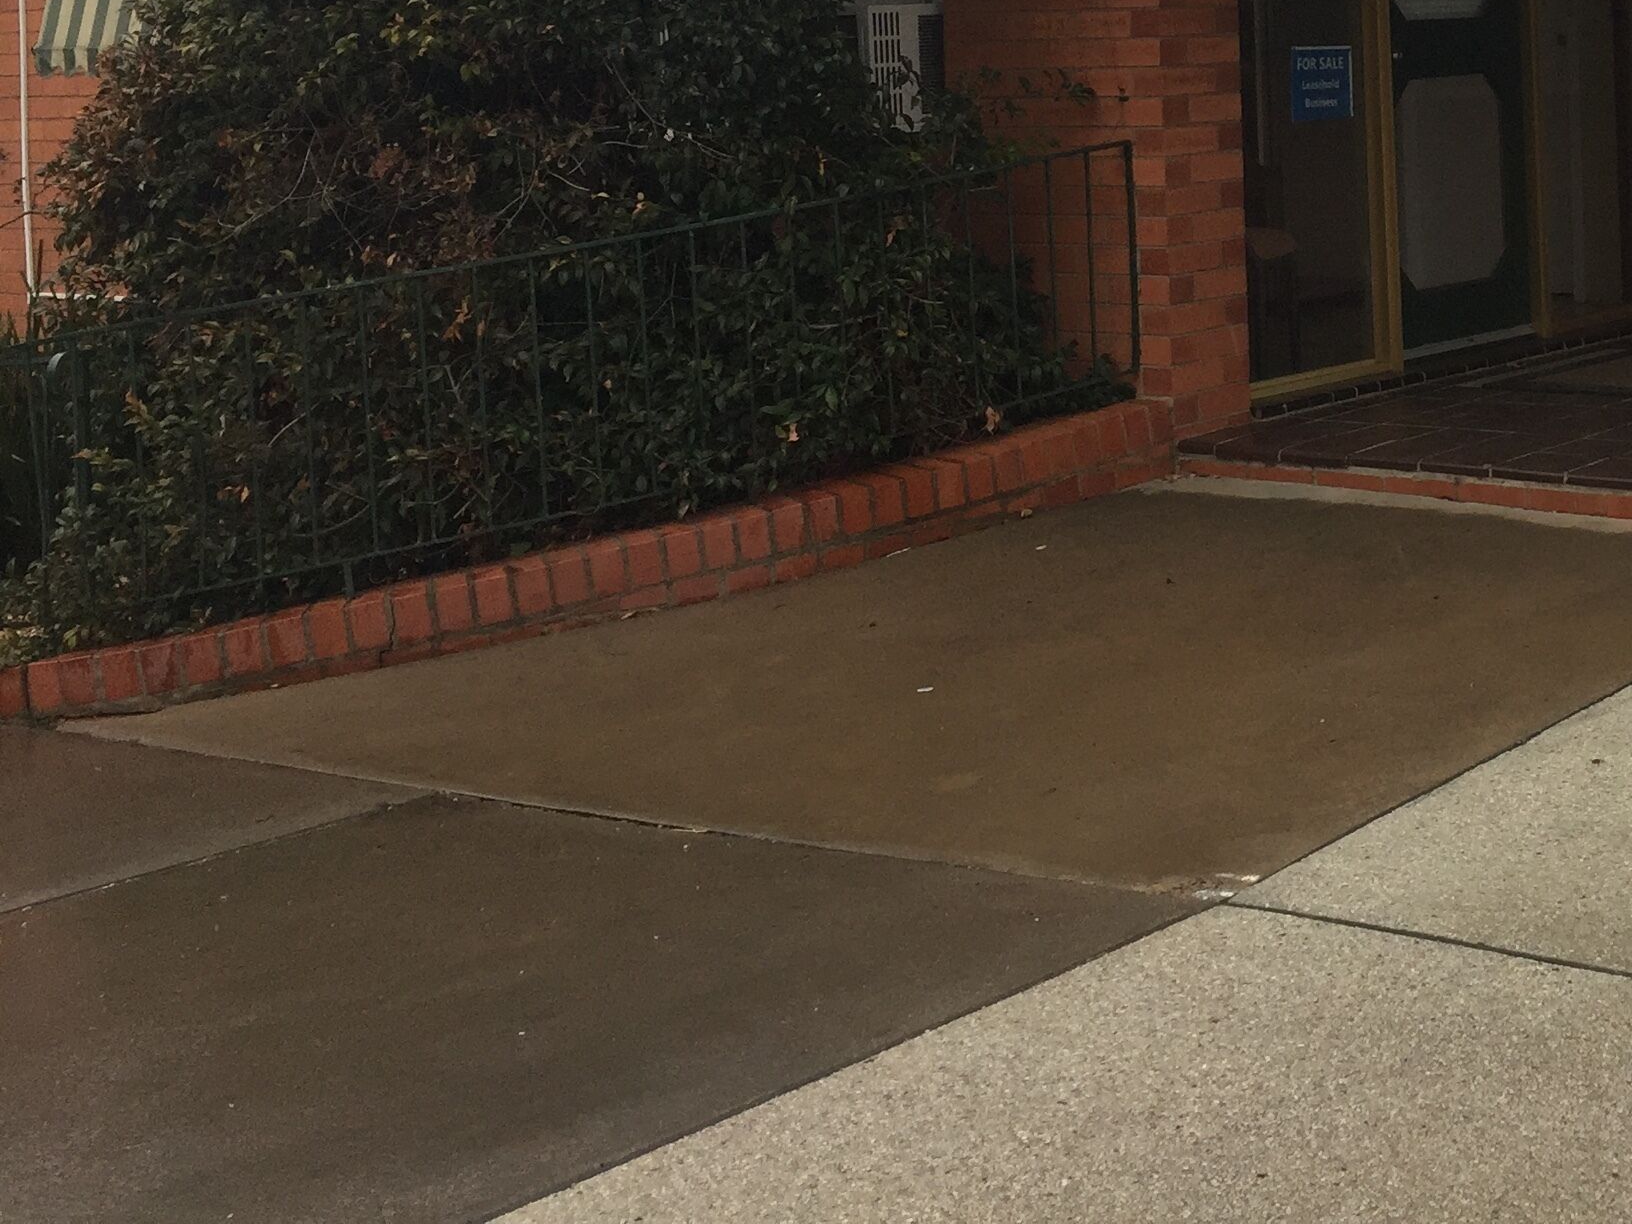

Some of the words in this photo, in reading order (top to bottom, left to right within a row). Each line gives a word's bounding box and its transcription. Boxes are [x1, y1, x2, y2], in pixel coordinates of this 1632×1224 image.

[1297, 57, 1317, 70] FOR
[1318, 56, 1345, 70] SALE
[1301, 79, 1340, 90] Leasehold
[1304, 97, 1338, 108] Business
